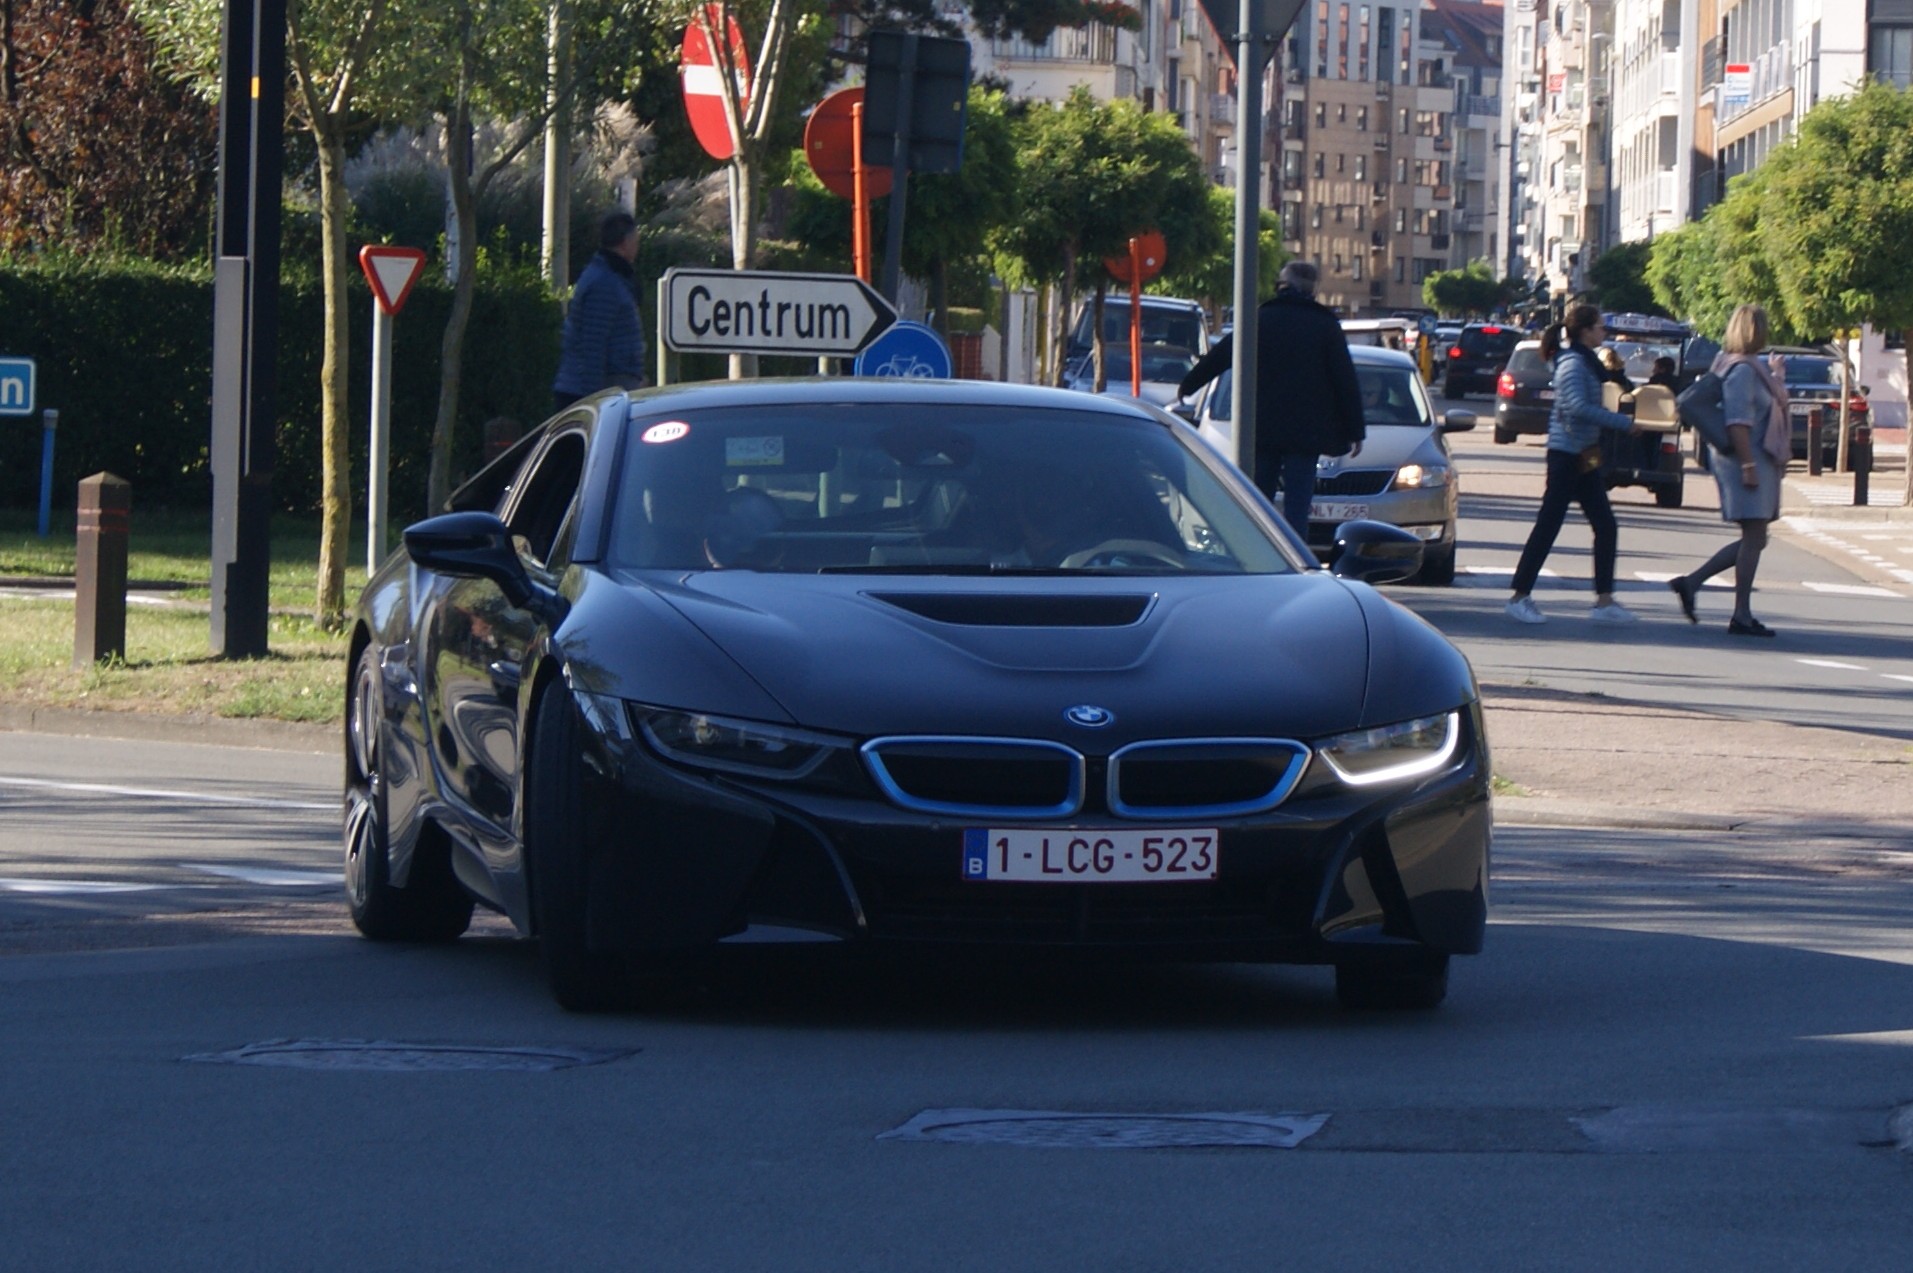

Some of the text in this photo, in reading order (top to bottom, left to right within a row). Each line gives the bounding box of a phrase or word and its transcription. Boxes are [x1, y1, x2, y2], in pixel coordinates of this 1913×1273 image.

[688, 285, 850, 339] Centrum
[969, 858, 983, 874] B
[996, 837, 1213, 874] 1-LCG-523
